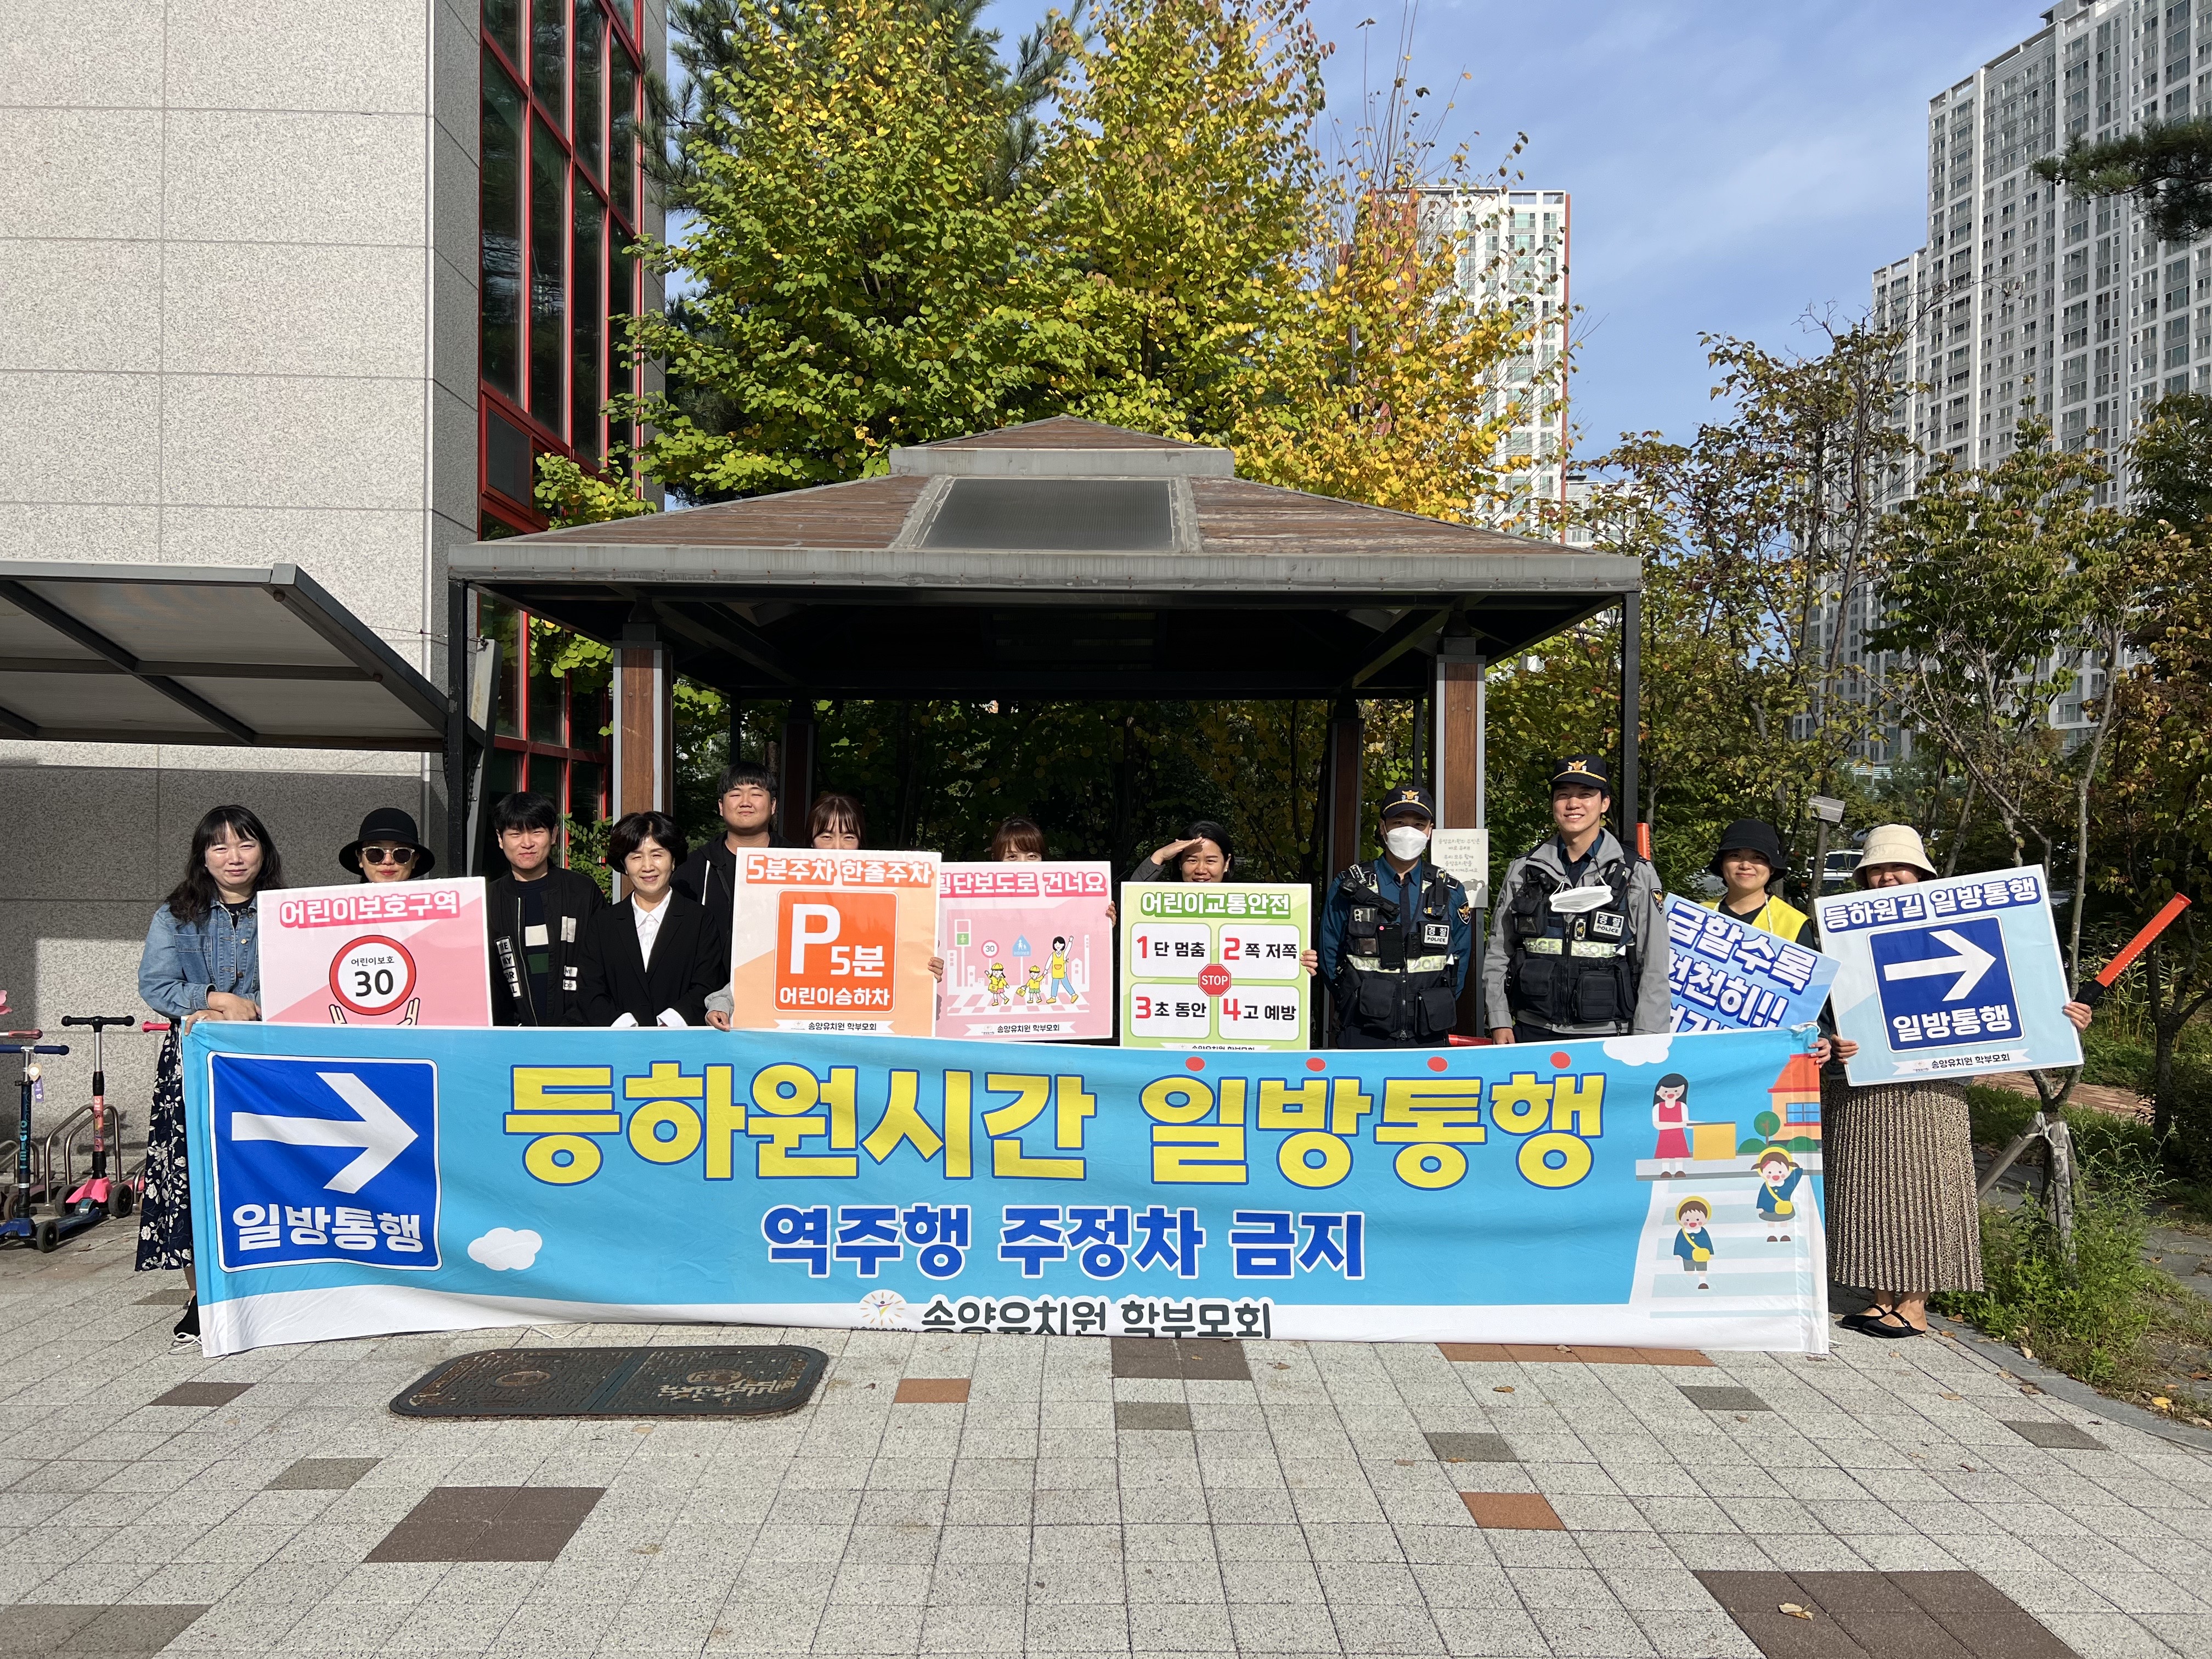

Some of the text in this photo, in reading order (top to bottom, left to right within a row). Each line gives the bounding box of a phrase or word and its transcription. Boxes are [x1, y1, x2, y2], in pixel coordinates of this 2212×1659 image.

[748, 855, 932, 884] 5분주차 한줄주차
[1043, 872, 1104, 893] 건너요
[281, 891, 458, 924] 어린이보호구역
[1142, 893, 1289, 915] 어린이교통안전
[1825, 877, 2038, 929] 등하원길 일방통행
[1428, 926, 1447, 936] 경찰
[1597, 925, 1619, 933] POLICE
[1599, 915, 1621, 927] 경찰
[790, 904, 840, 974] P
[1175, 941, 1205, 958] 멈춤
[1668, 901, 1817, 993] 급할수록
[351, 956, 395, 967] 어린이보호
[830, 945, 885, 977] 5분
[1266, 943, 1297, 959] 저쪽
[354, 969, 394, 997] 30
[1201, 975, 1228, 986] STOP
[780, 987, 890, 1006] 어린이승하차
[1175, 1002, 1206, 1018] 동안
[1265, 1005, 1296, 1021] 예방
[808, 1022, 877, 1031] 송양유치원 학부모회
[1893, 1005, 2012, 1042] 일방통행
[1931, 1053, 2010, 1069] 송양유치원 학부모회
[503, 1060, 1606, 1190] 등하원시간 일방통행
[232, 1203, 424, 1253] 일방통행
[764, 1205, 1363, 1277] 역주행 주정차 금지
[1121, 1300, 1271, 1339] 학부모회
